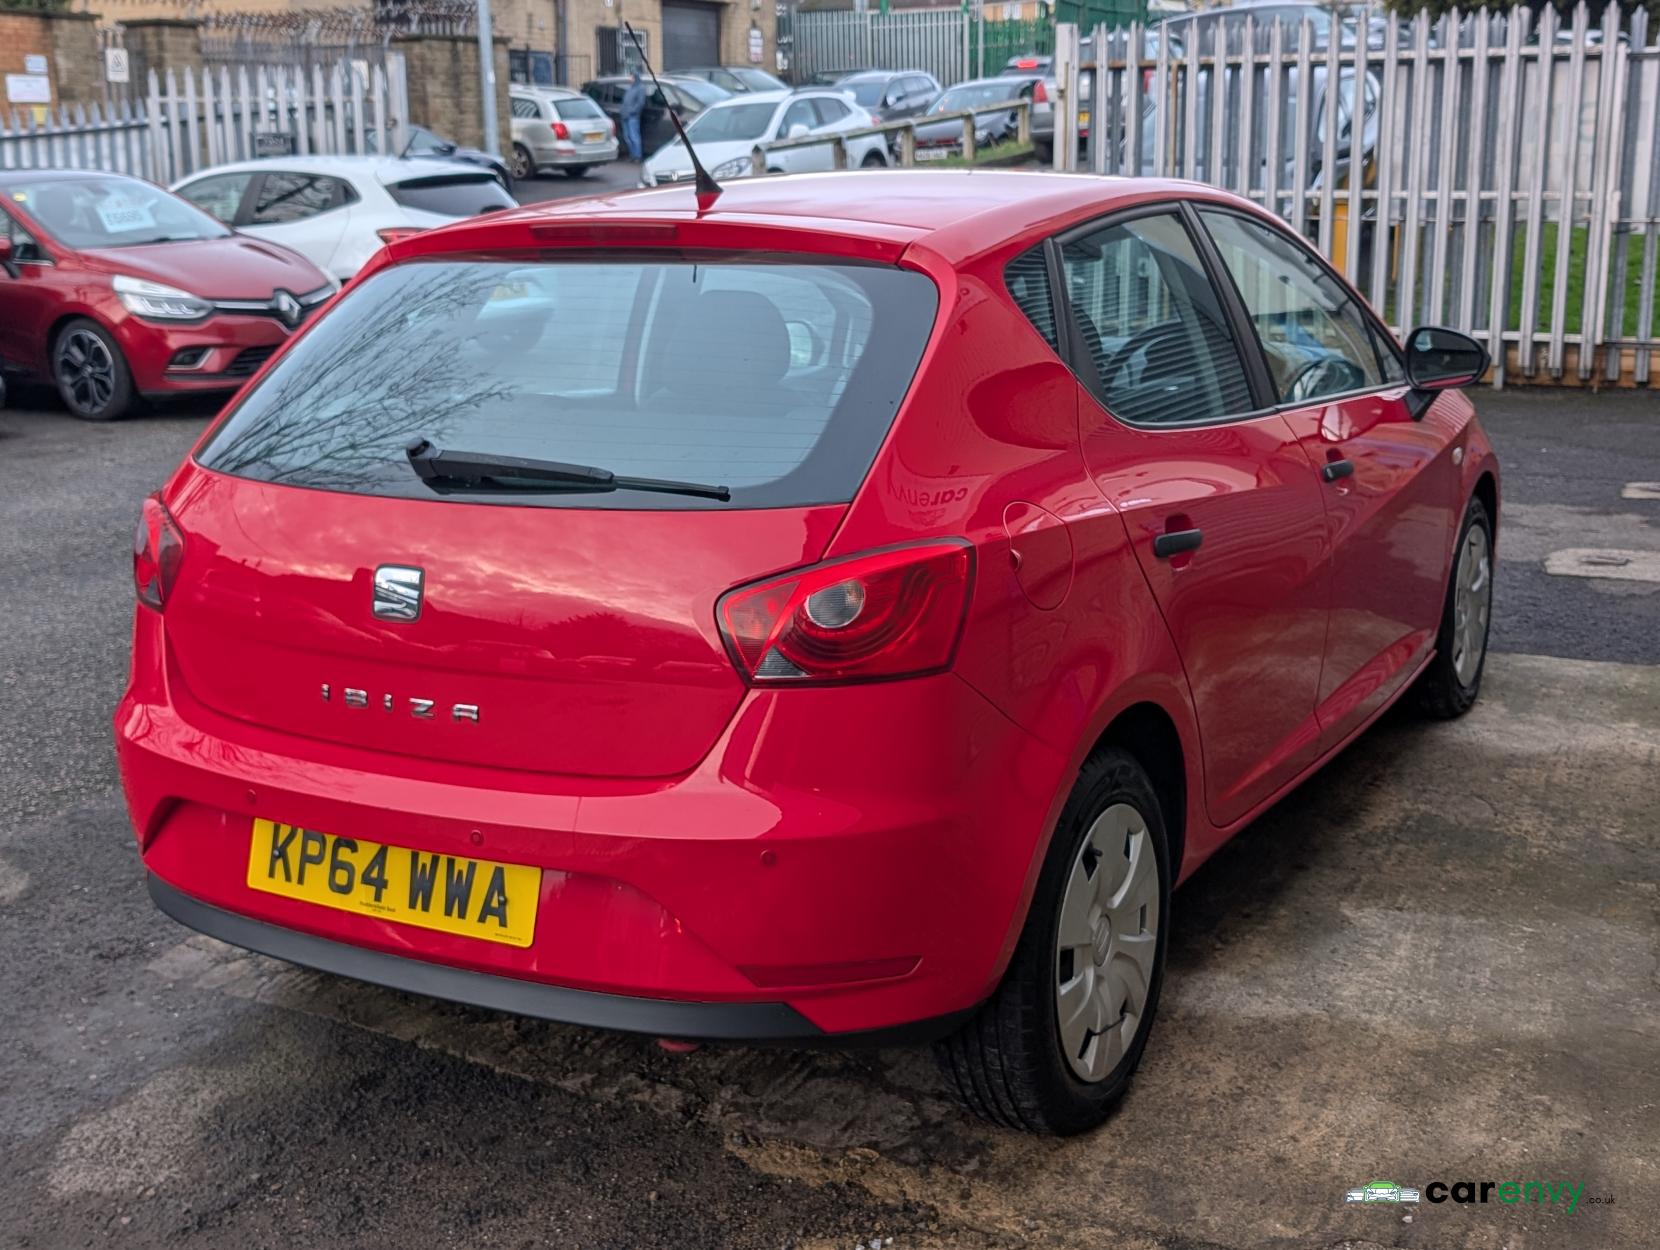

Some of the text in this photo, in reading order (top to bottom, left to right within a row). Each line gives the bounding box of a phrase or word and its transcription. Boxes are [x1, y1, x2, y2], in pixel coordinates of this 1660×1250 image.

[321, 683, 481, 722] IBIZA
[267, 823, 508, 929] KP64 WWA
